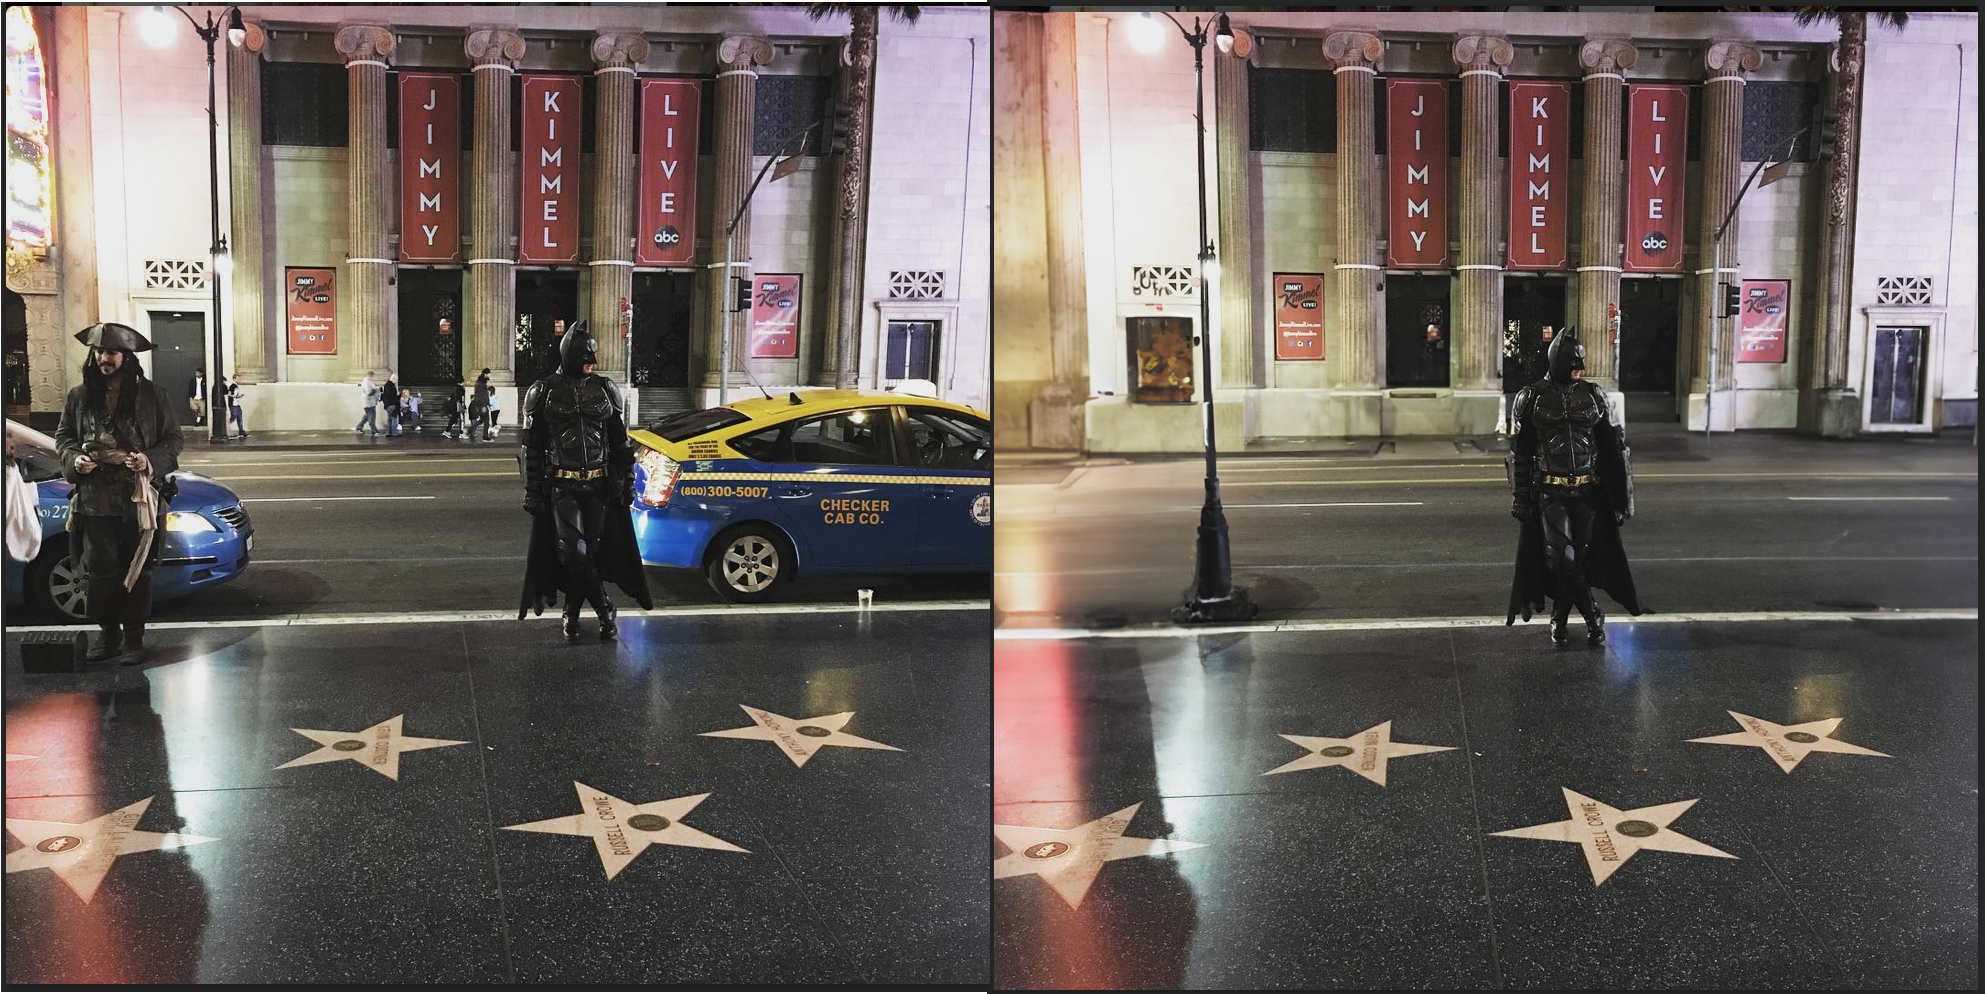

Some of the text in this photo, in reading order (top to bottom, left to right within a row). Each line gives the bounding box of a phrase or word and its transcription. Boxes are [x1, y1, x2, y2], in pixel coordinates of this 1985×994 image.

[660, 94, 678, 214] LIVE
[1648, 99, 1666, 220] LIVE
[419, 88, 441, 247] JIMMY
[540, 90, 563, 249] KIMMEL
[1407, 95, 1429, 253] JIMMY
[1528, 96, 1550, 255] KIMMEL
[654, 231, 680, 245] abc
[1642, 236, 1667, 250] abc
[290, 279, 332, 303] Kimmel
[755, 284, 797, 307] Kimmel
[1278, 284, 1321, 309] Kimmel
[1743, 289, 1785, 313] Kimmel
[681, 486, 768, 498] (800) 300-5007
[820, 499, 890, 512] CHECKER
[824, 512, 884, 525] CAB CO.
[593, 796, 632, 855] RUSSELL CROWE
[1581, 803, 1620, 861] RUSSELL CROWE
